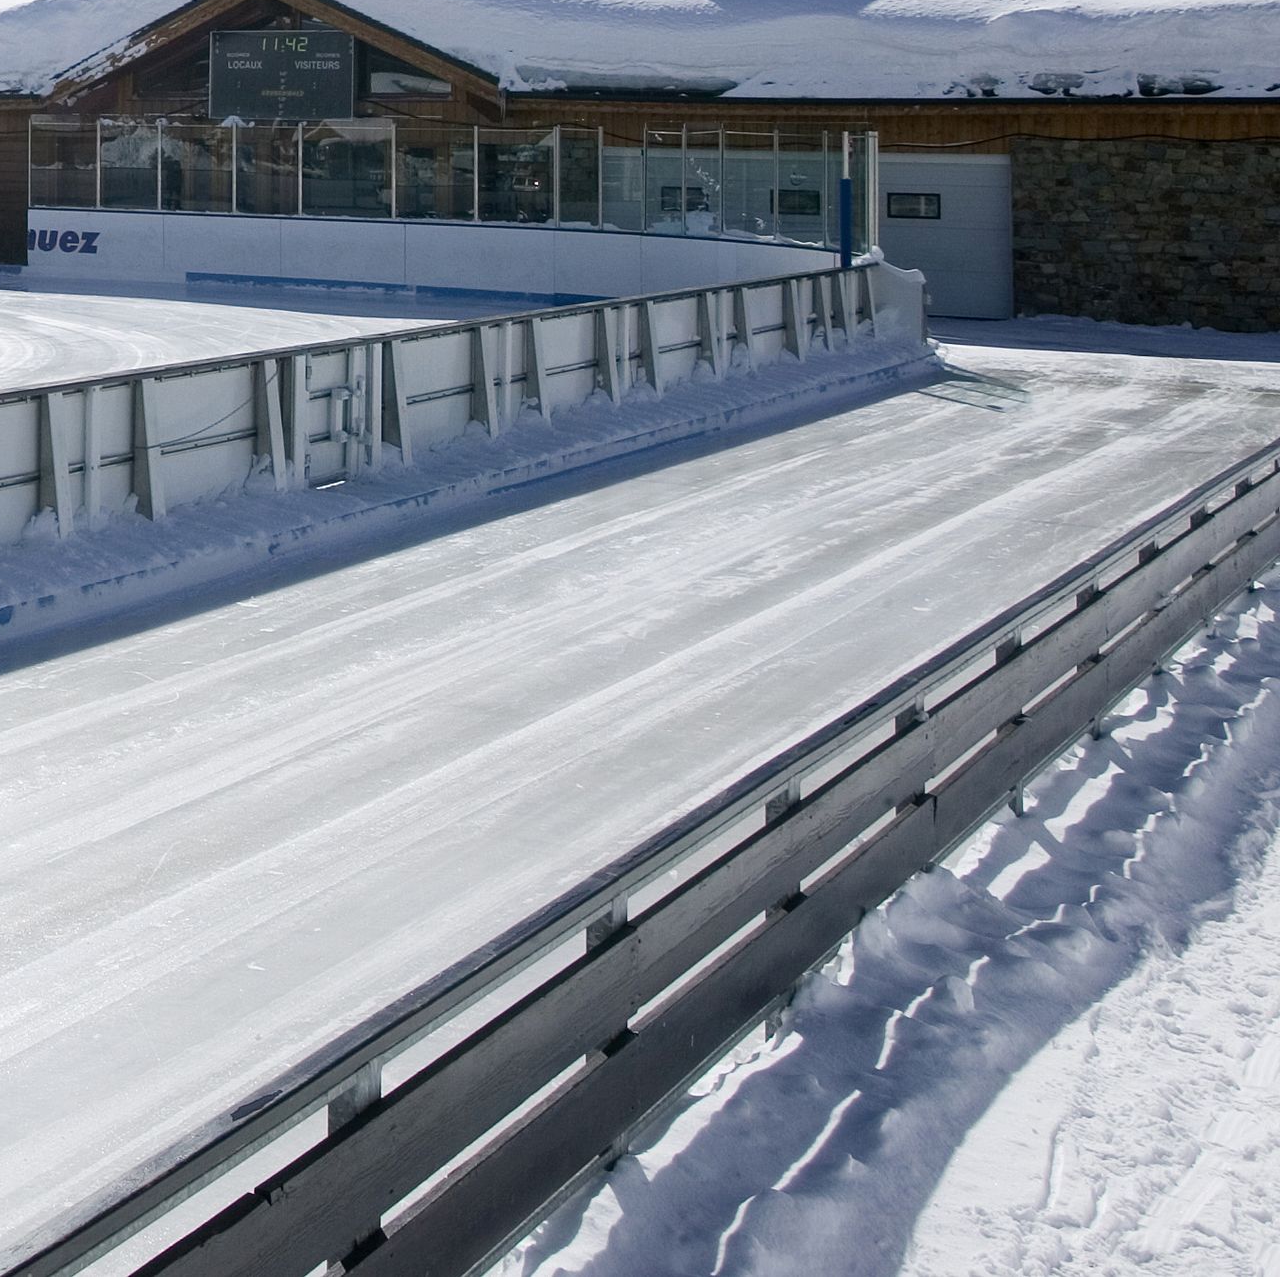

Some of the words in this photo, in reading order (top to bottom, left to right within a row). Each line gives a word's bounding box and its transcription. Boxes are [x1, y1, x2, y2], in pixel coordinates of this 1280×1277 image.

[262, 36, 309, 52] 11:42
[227, 61, 262, 69] LOCAUX
[294, 61, 340, 70] VISITEURS
